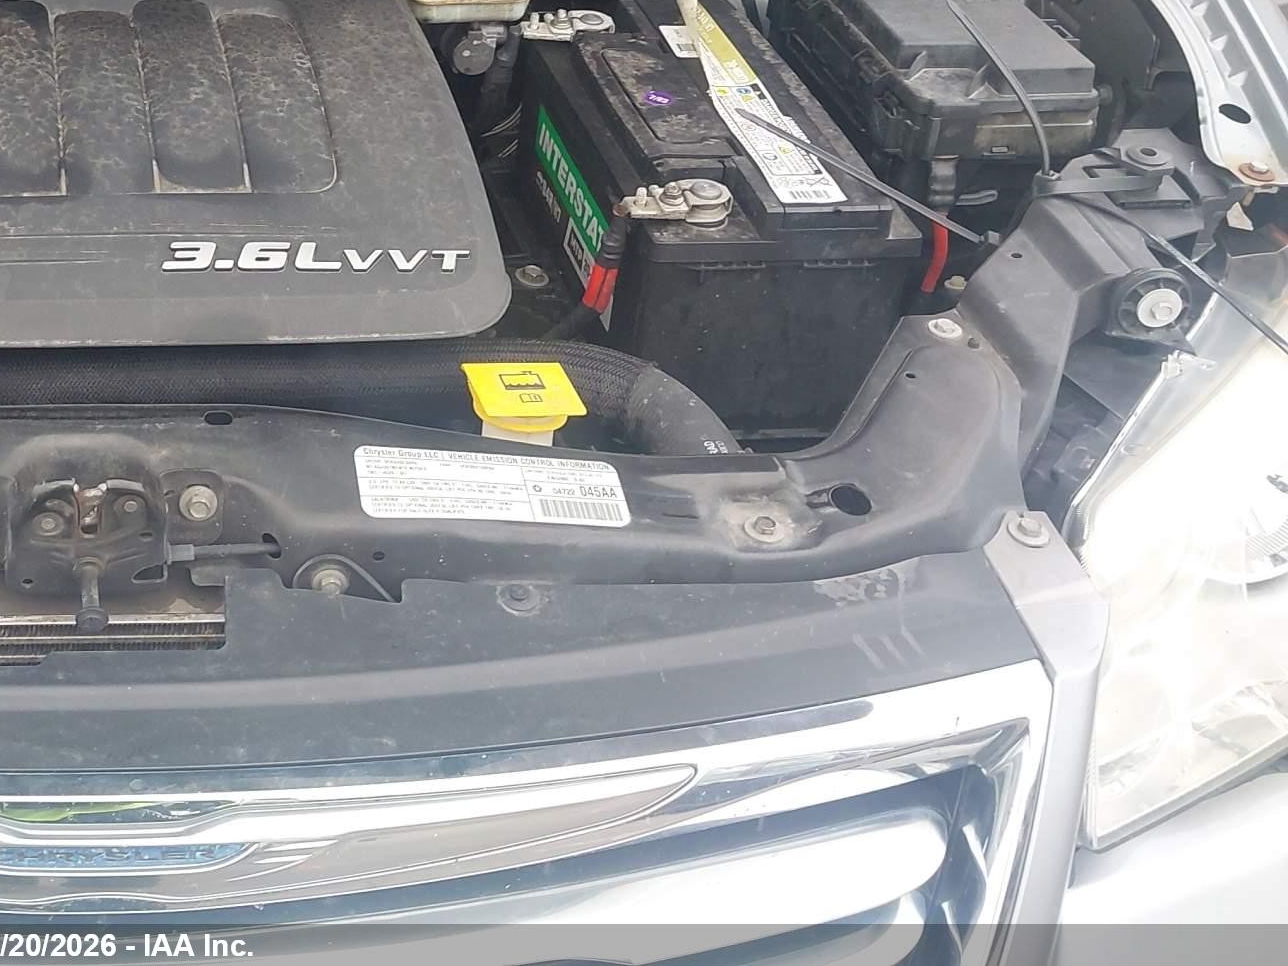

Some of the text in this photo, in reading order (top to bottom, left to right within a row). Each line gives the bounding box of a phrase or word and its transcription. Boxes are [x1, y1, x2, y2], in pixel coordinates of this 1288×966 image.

[539, 123, 605, 252] INTERSTAT
[398, 449, 422, 458] Group
[449, 453, 479, 461] VEHICLE
[482, 455, 518, 464] EMISSION
[520, 458, 554, 467] CONTROL
[557, 460, 610, 470] INFORMATION
